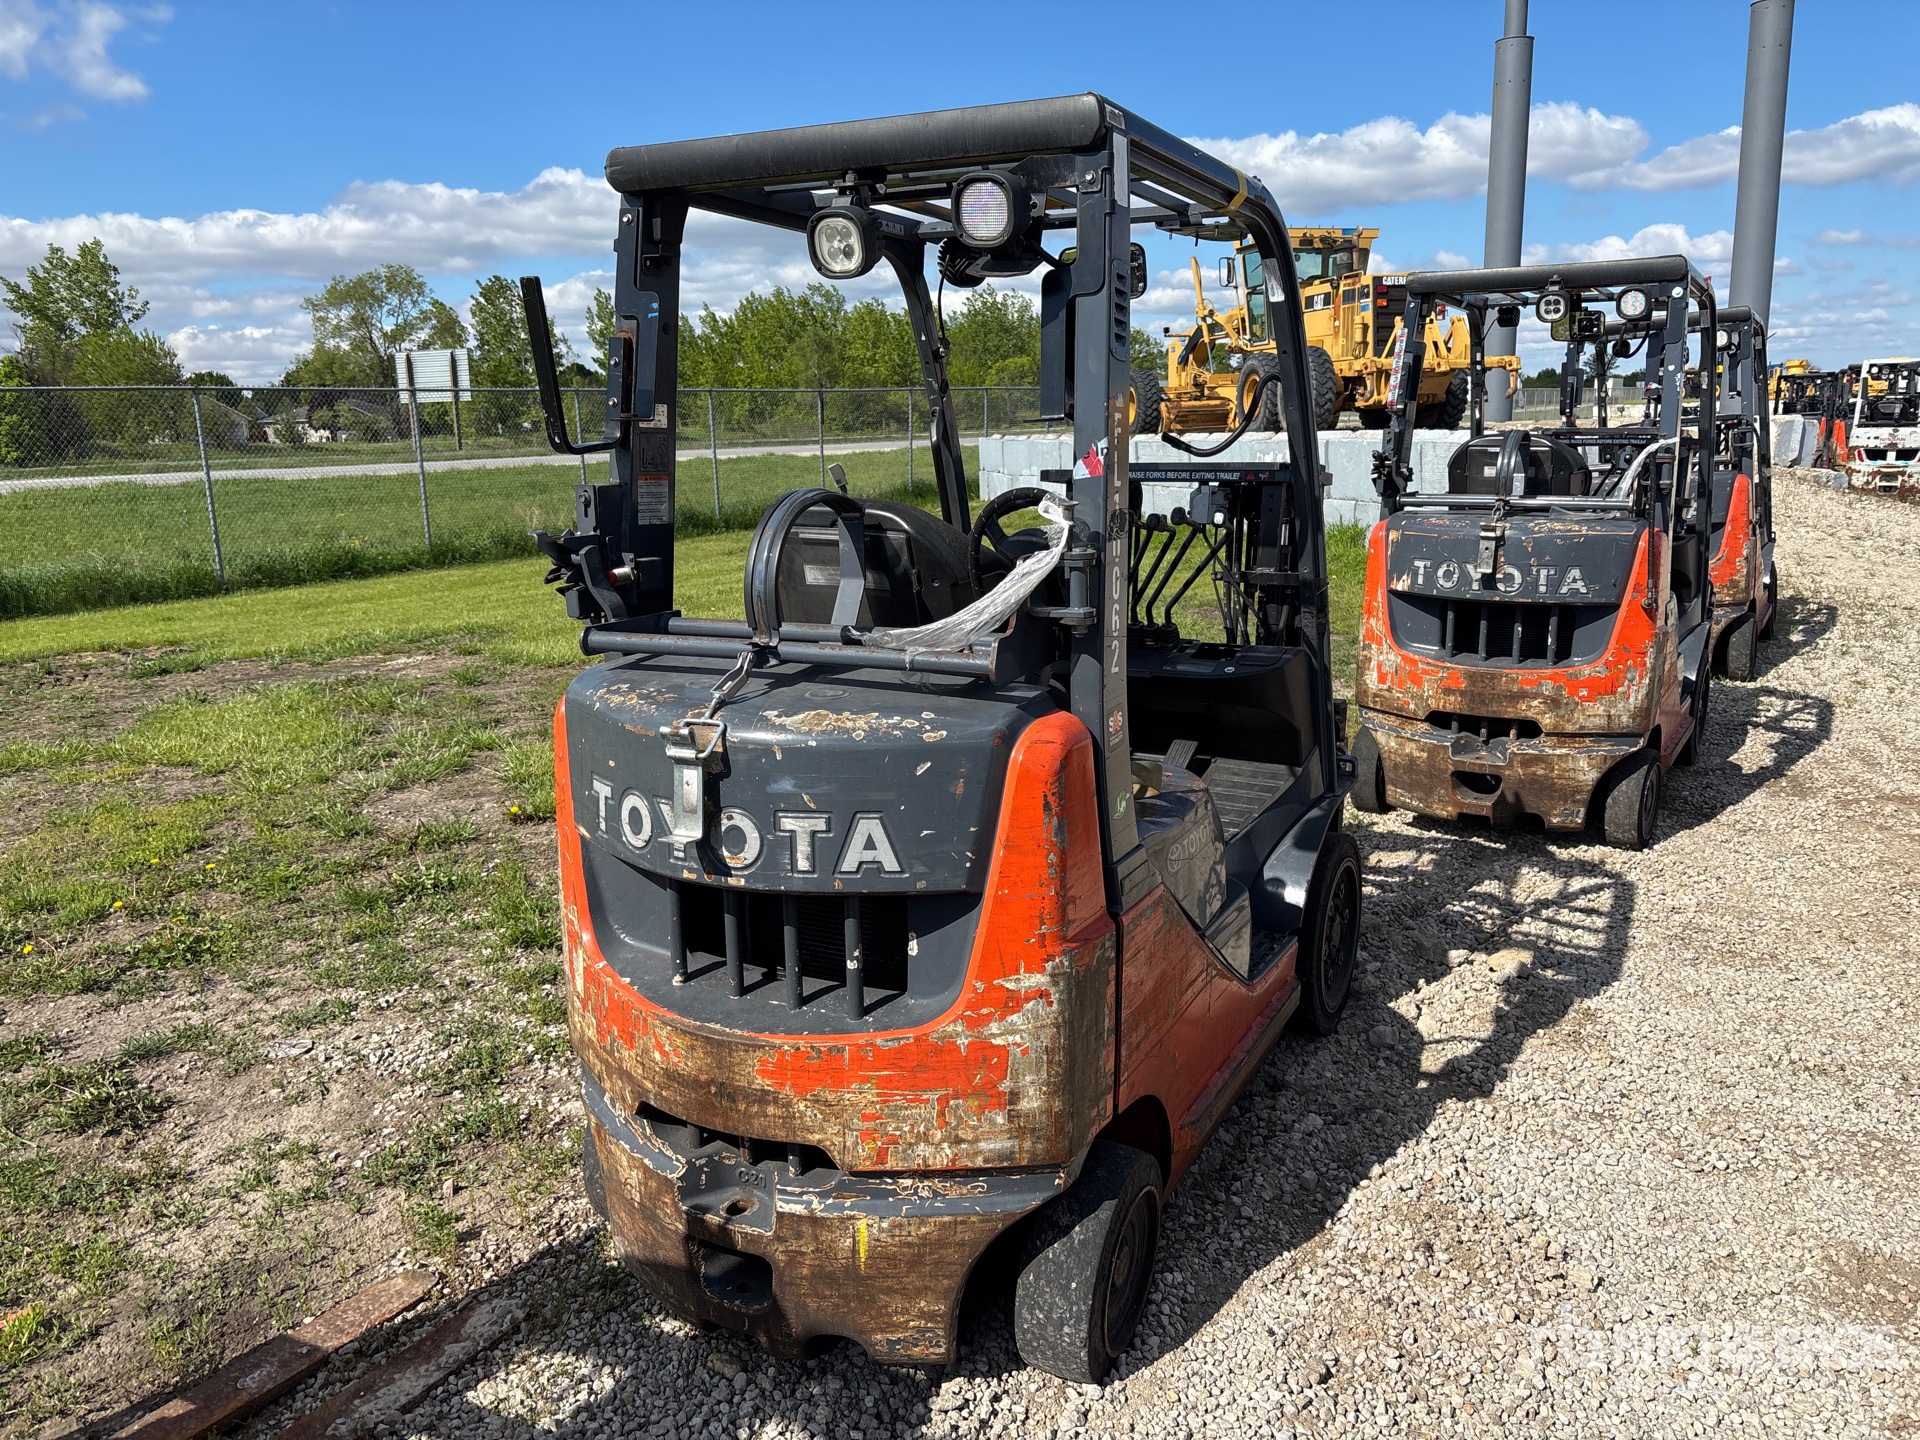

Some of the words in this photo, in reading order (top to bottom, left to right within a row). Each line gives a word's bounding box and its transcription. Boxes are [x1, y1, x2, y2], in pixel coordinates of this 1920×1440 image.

[1128, 471, 1145, 479] RAISE
[1146, 471, 1166, 479] FORKS
[1167, 471, 1191, 479] BEFORE
[1191, 472, 1215, 480] EXITING
[1412, 558, 1589, 595] TOYOTA
